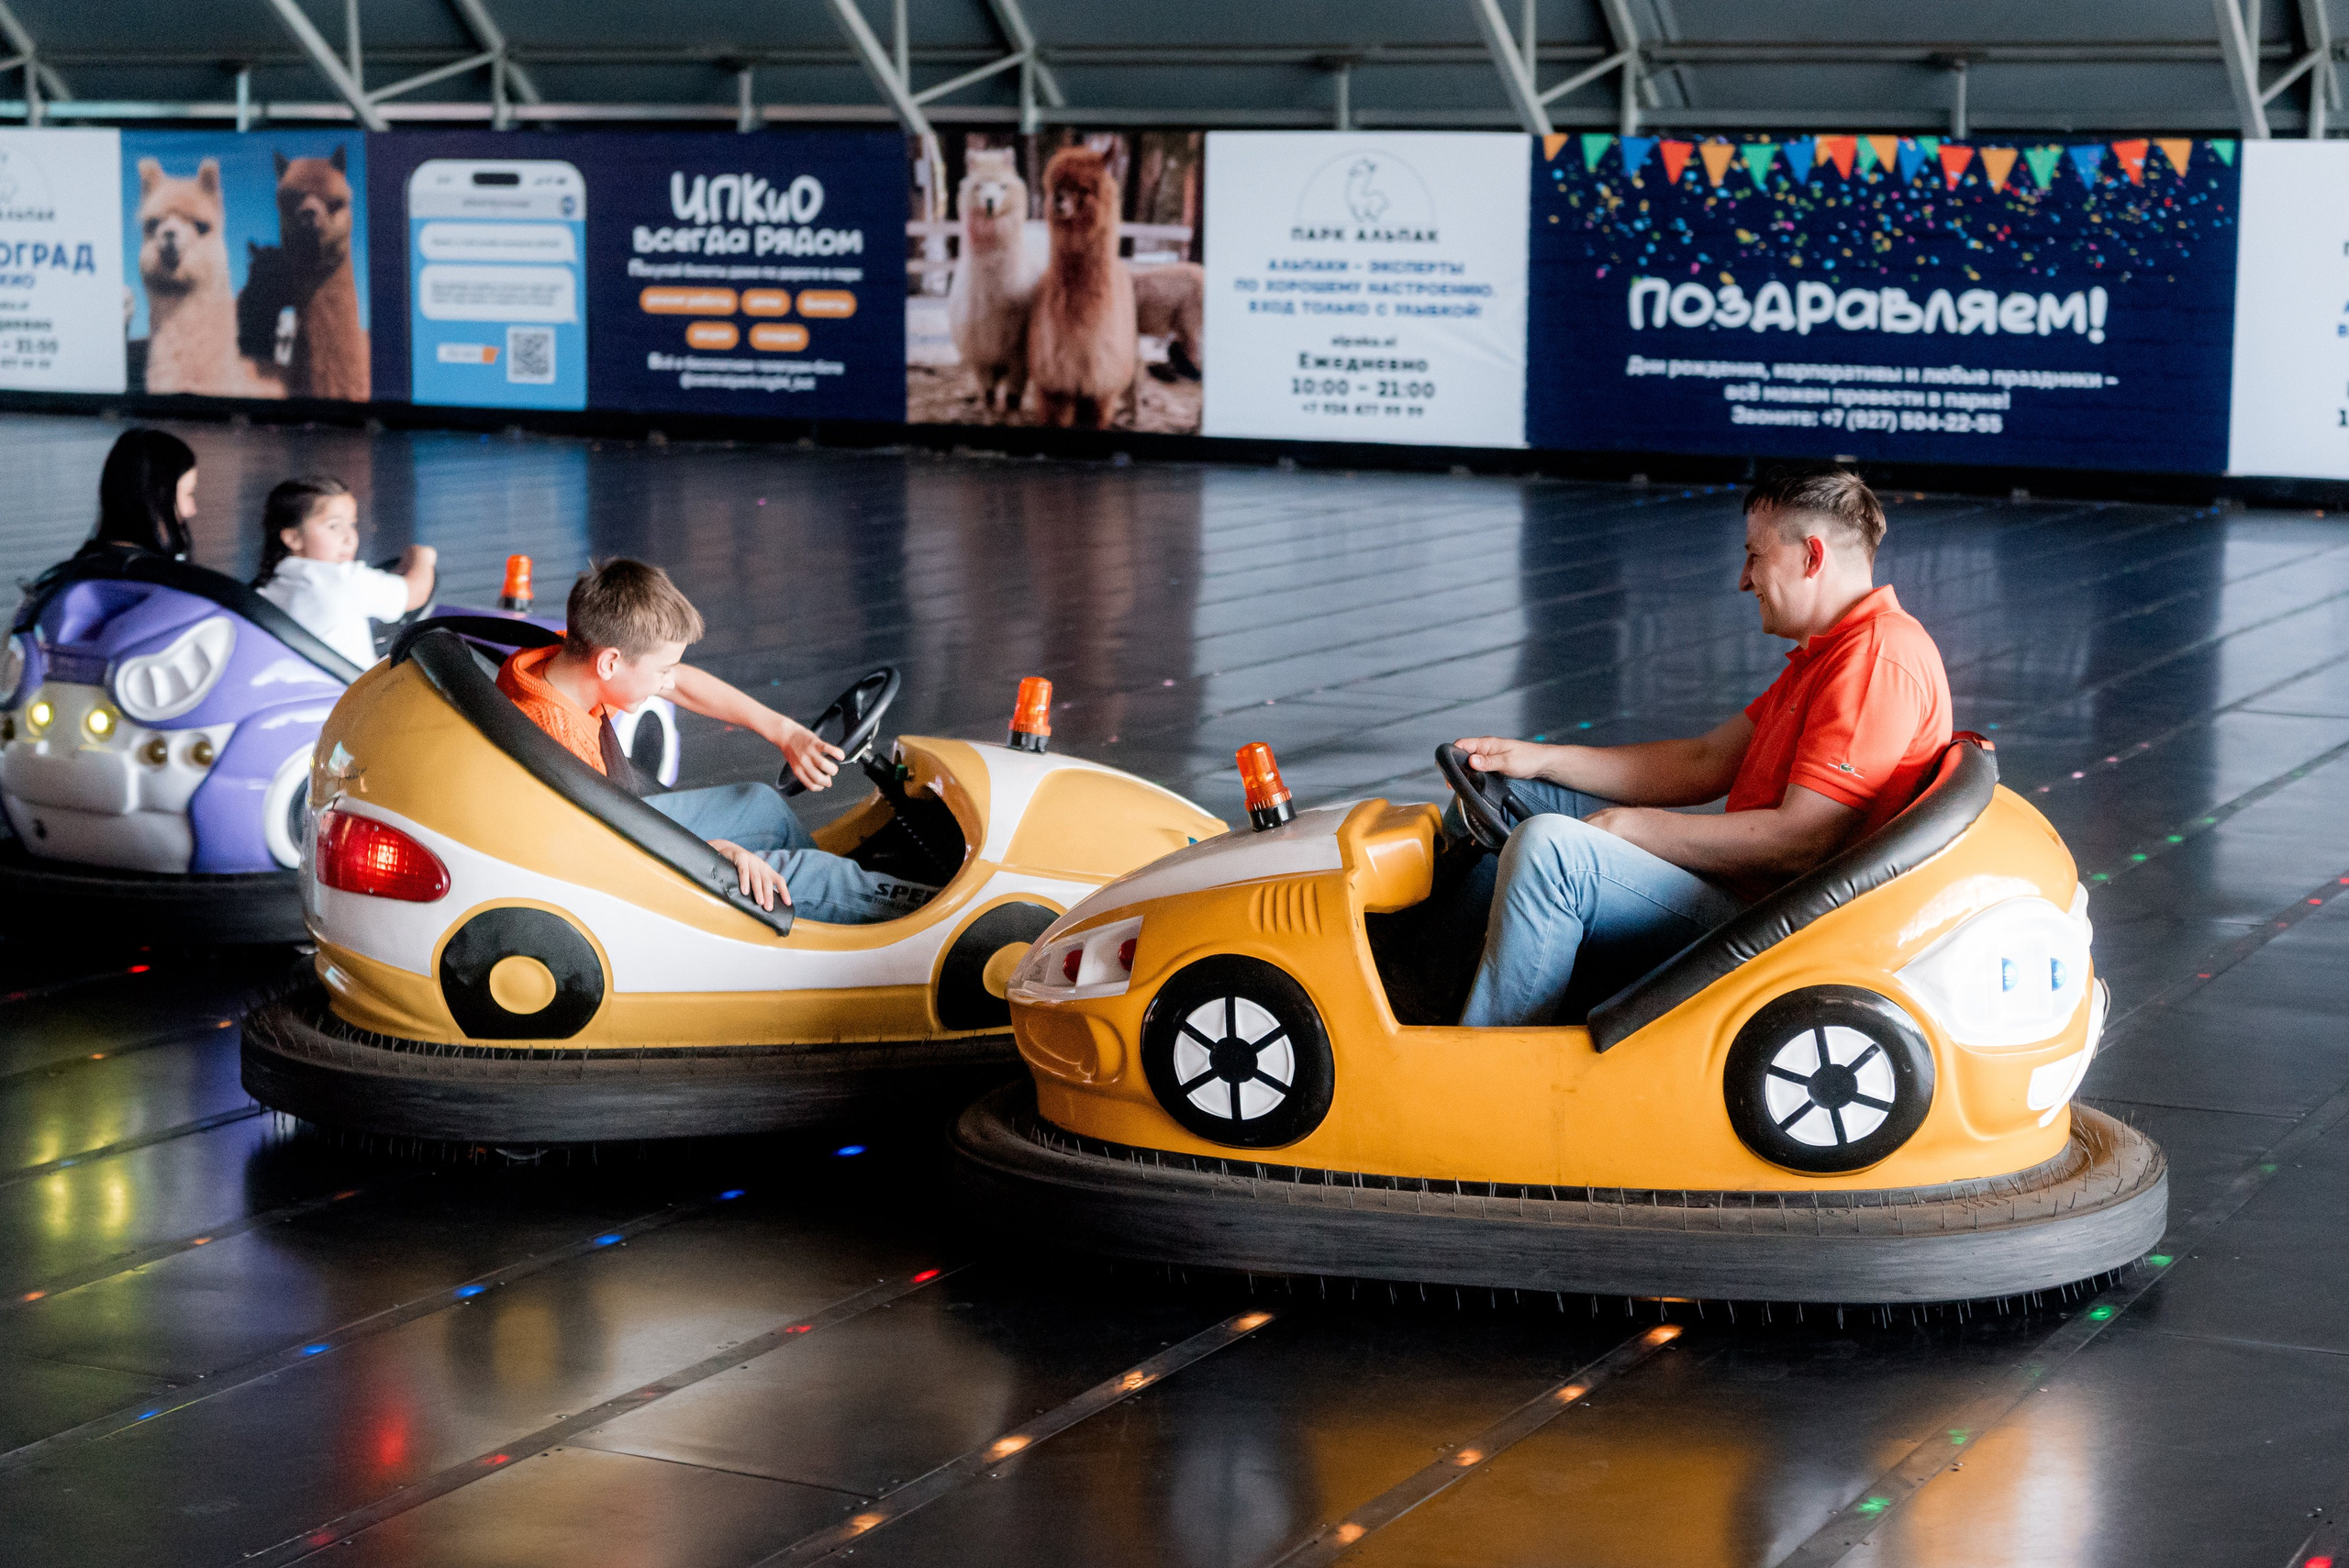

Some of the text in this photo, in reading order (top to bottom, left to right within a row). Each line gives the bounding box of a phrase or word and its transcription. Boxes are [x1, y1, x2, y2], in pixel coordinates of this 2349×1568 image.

[1291, 227, 1439, 243] ПАРК АЛЬПАК
[1370, 260, 1464, 275] ЭКСПЕРТЫ
[1291, 376, 1349, 396] 10:00
[1377, 380, 1436, 399] 21:00
